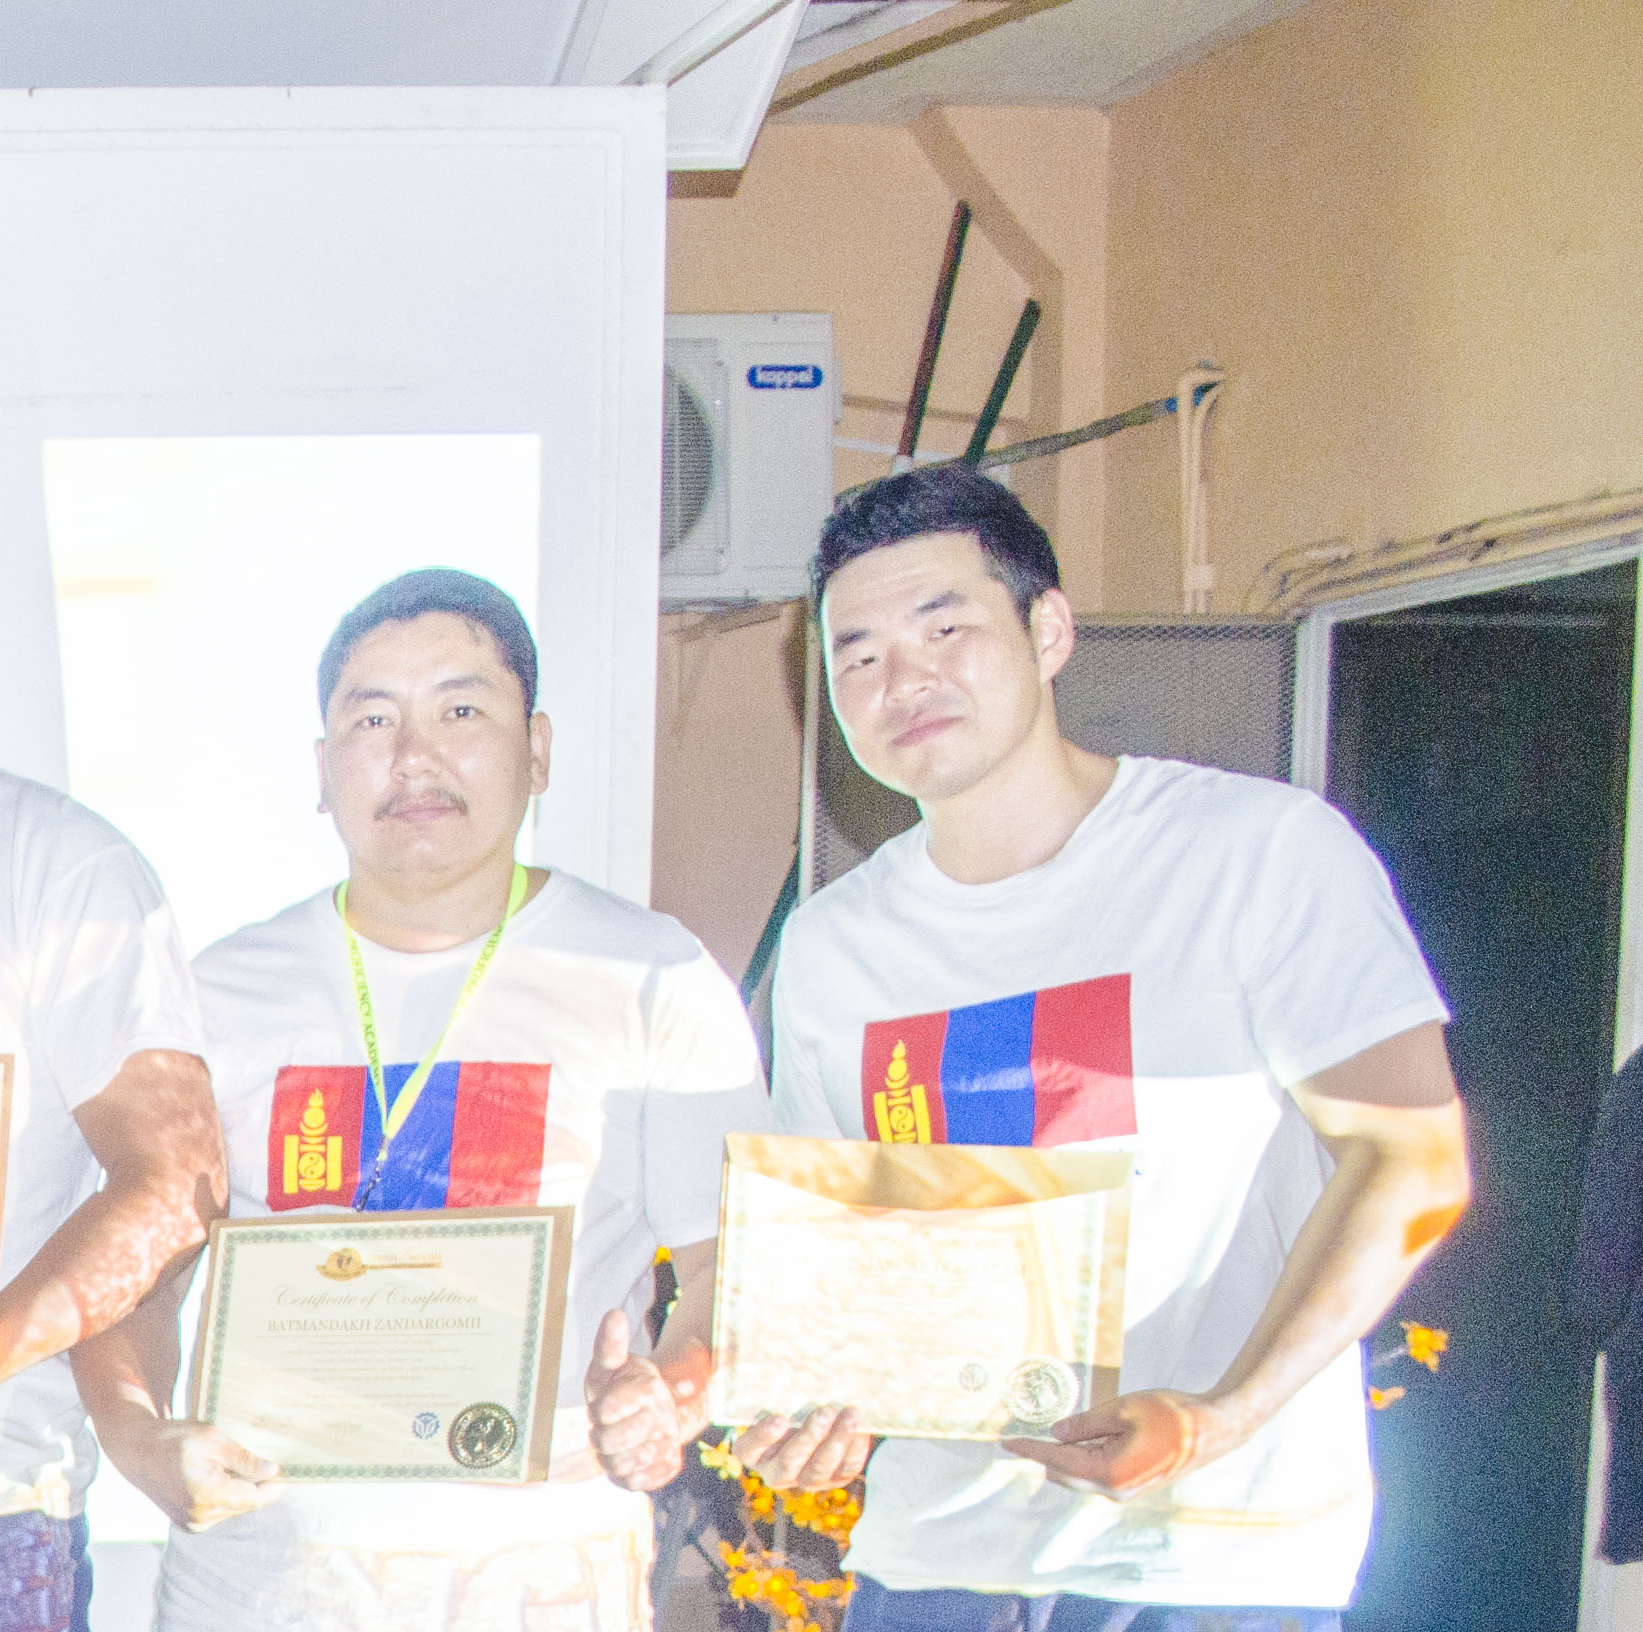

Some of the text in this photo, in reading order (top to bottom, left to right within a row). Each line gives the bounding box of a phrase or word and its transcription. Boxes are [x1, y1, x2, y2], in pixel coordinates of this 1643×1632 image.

[272, 1281, 479, 1312] Certificate of Completion
[267, 1318, 371, 1332] BATMANDAKH
